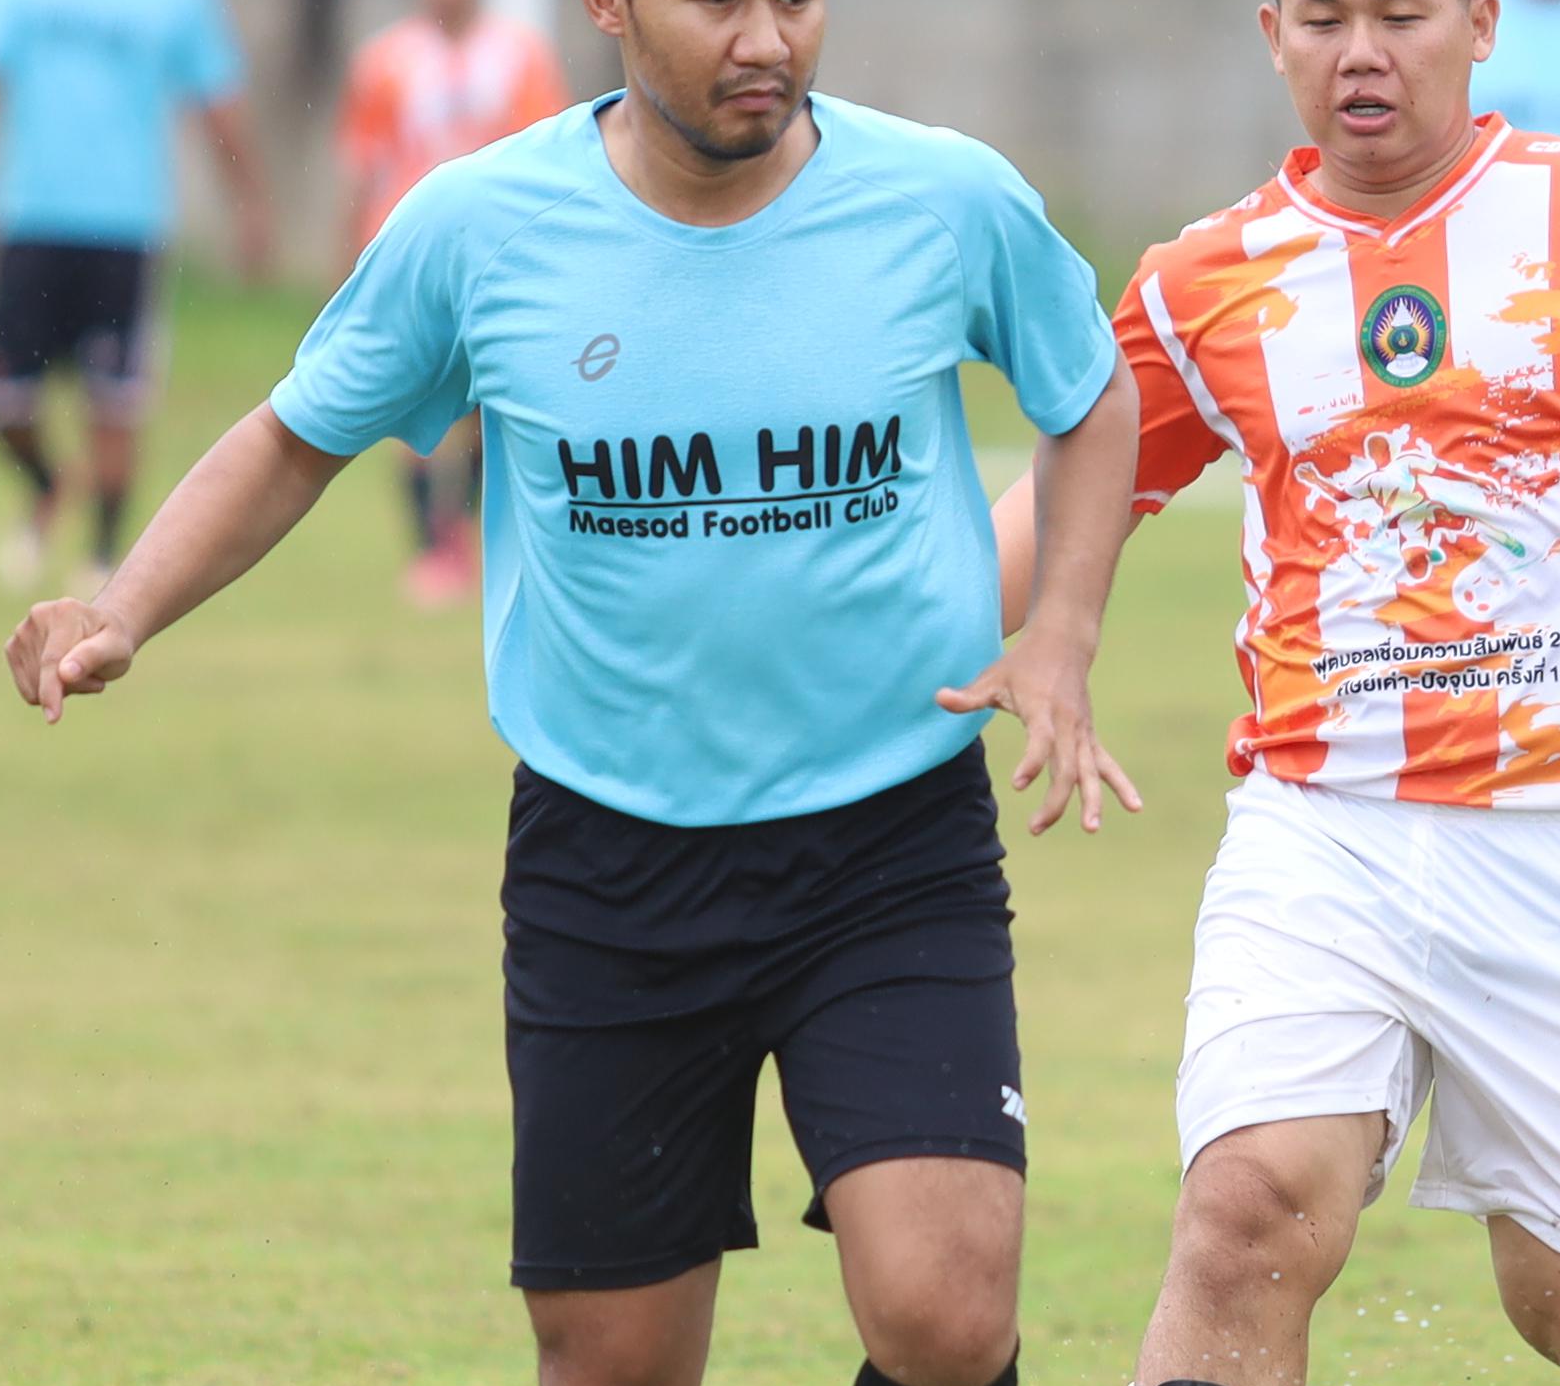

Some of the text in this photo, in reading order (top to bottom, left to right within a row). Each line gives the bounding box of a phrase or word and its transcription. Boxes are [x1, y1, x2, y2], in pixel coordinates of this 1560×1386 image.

[558, 415, 902, 500] HIM HIM
[569, 487, 900, 539] Maesod Football Club
[1550, 666, 1559, 683] 1
